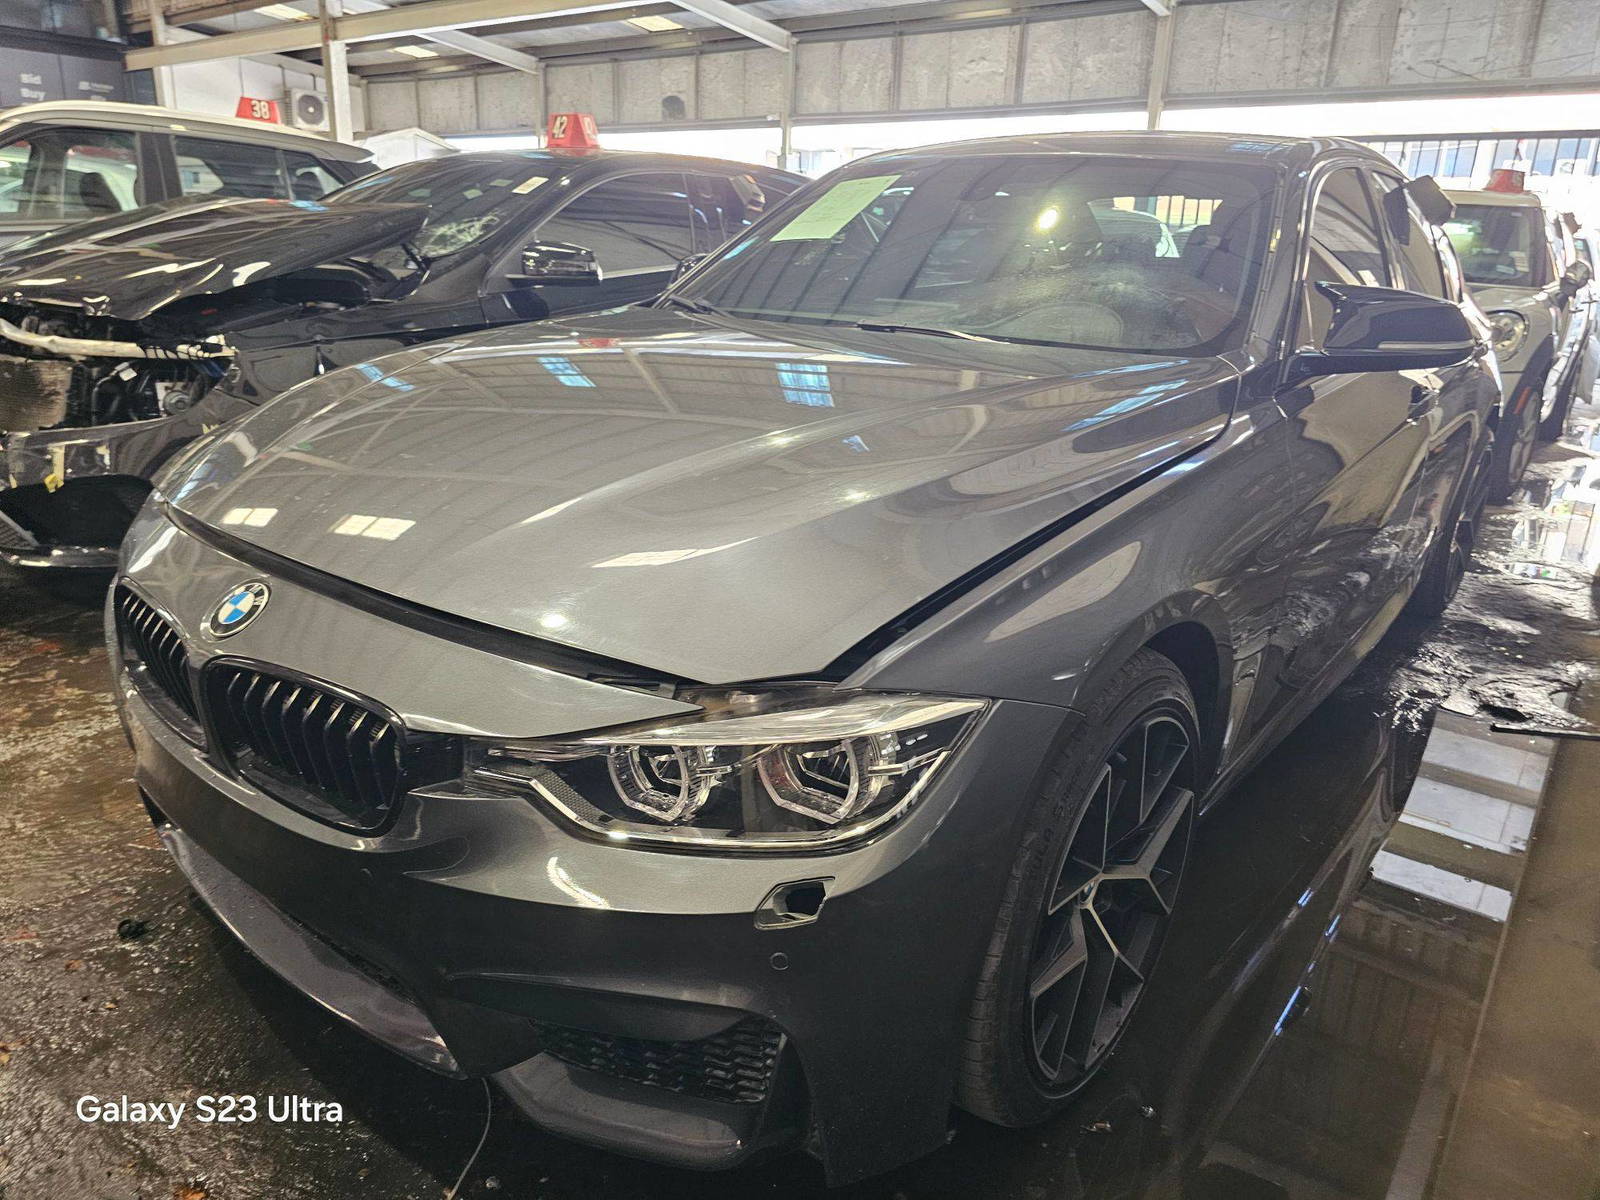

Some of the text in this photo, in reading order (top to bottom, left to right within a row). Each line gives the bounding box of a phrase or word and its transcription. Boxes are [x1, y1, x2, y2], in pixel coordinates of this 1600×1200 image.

[20, 88, 47, 102] Buy
[250, 99, 271, 120] 38
[552, 115, 568, 139] 42
